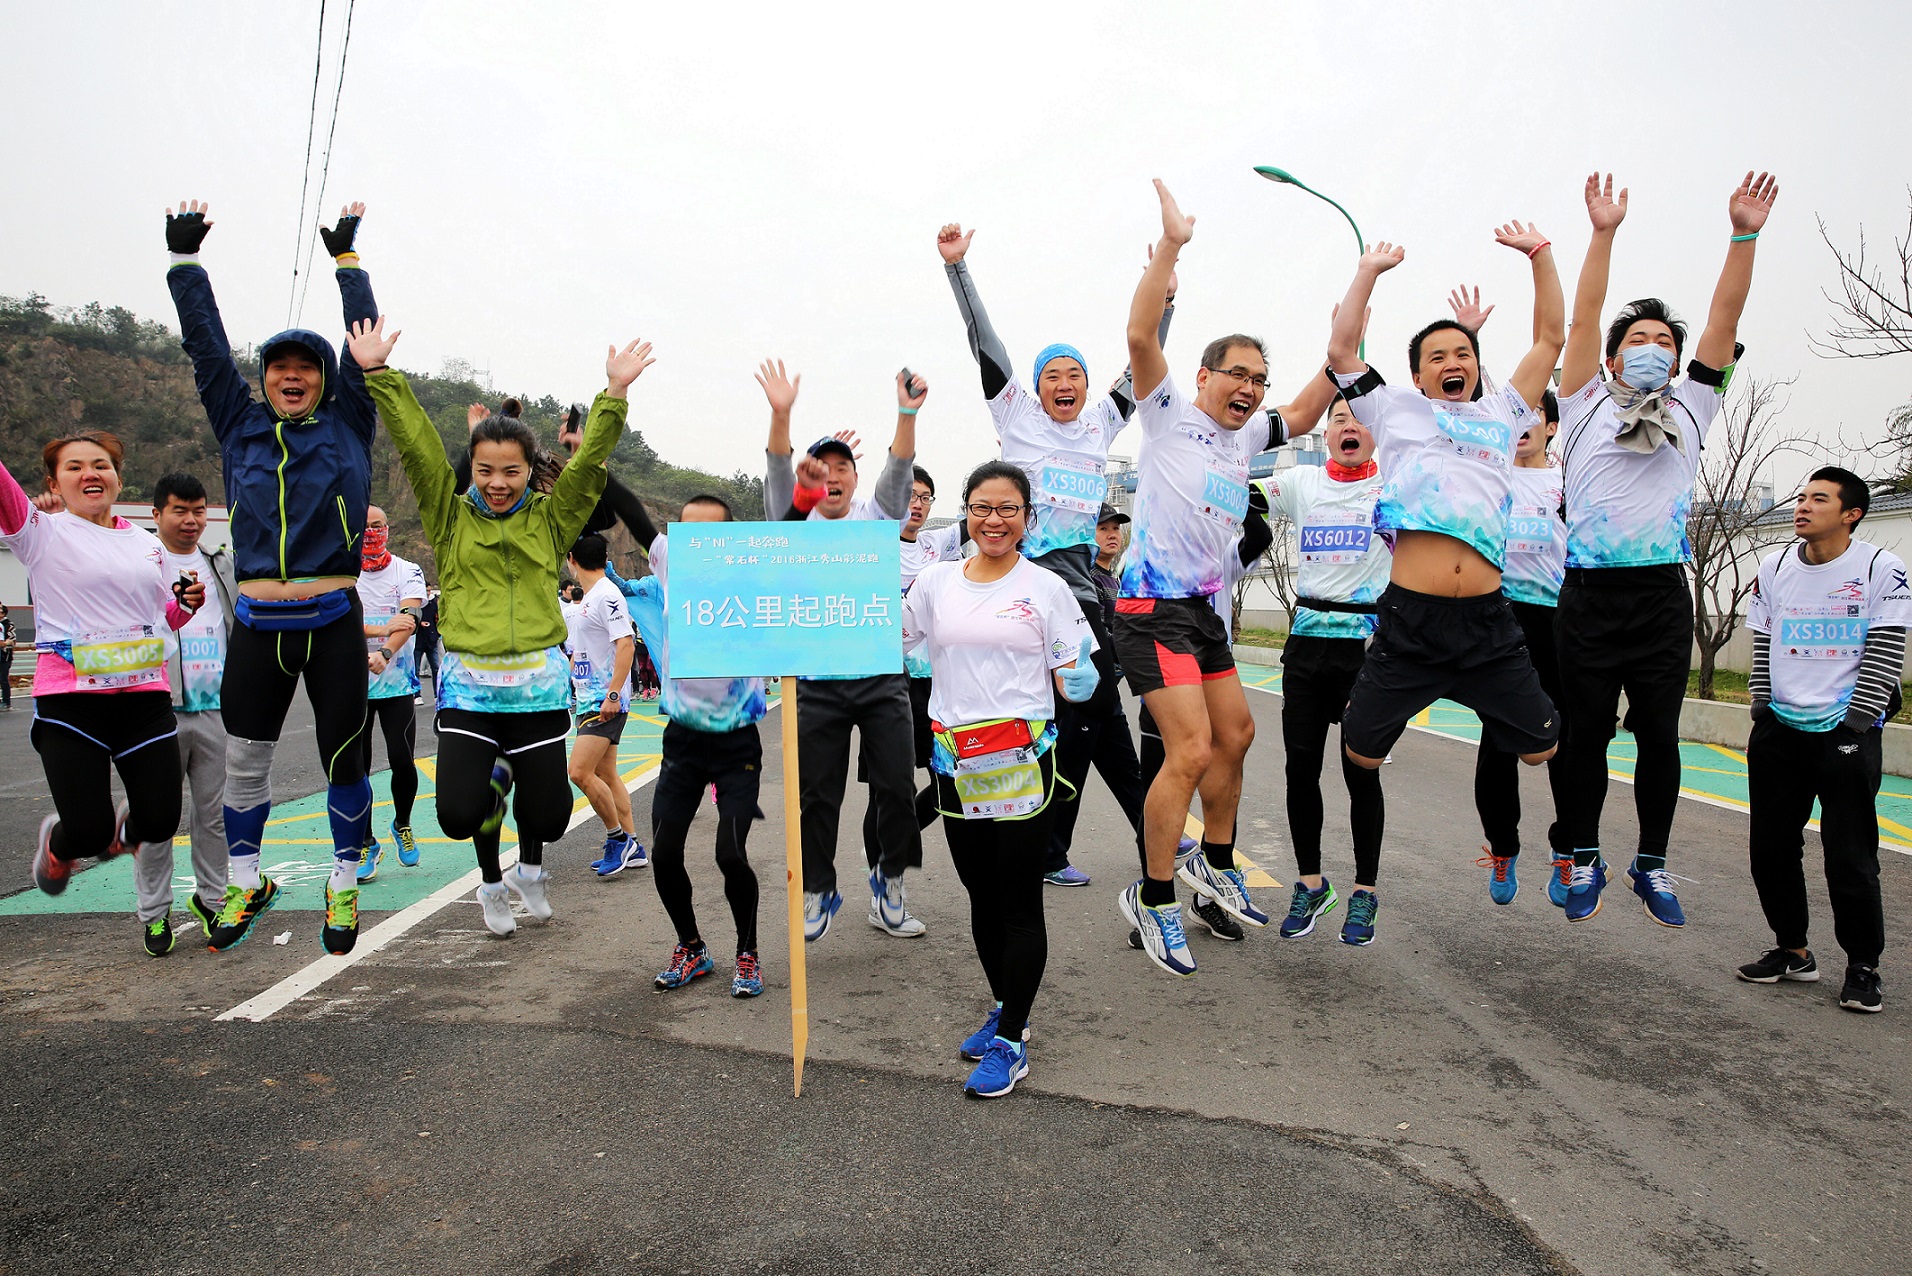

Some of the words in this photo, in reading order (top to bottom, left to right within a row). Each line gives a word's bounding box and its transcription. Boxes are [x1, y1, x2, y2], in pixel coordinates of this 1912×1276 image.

[1047, 471, 1105, 497] XS3006
[1304, 530, 1366, 547] XS6012
[1510, 520, 1549, 537] 3023
[681, 593, 893, 629] 18公里起跑点
[1787, 623, 1862, 640] XS3014
[82, 643, 159, 669] XS3005
[962, 769, 1037, 796] XS3004
